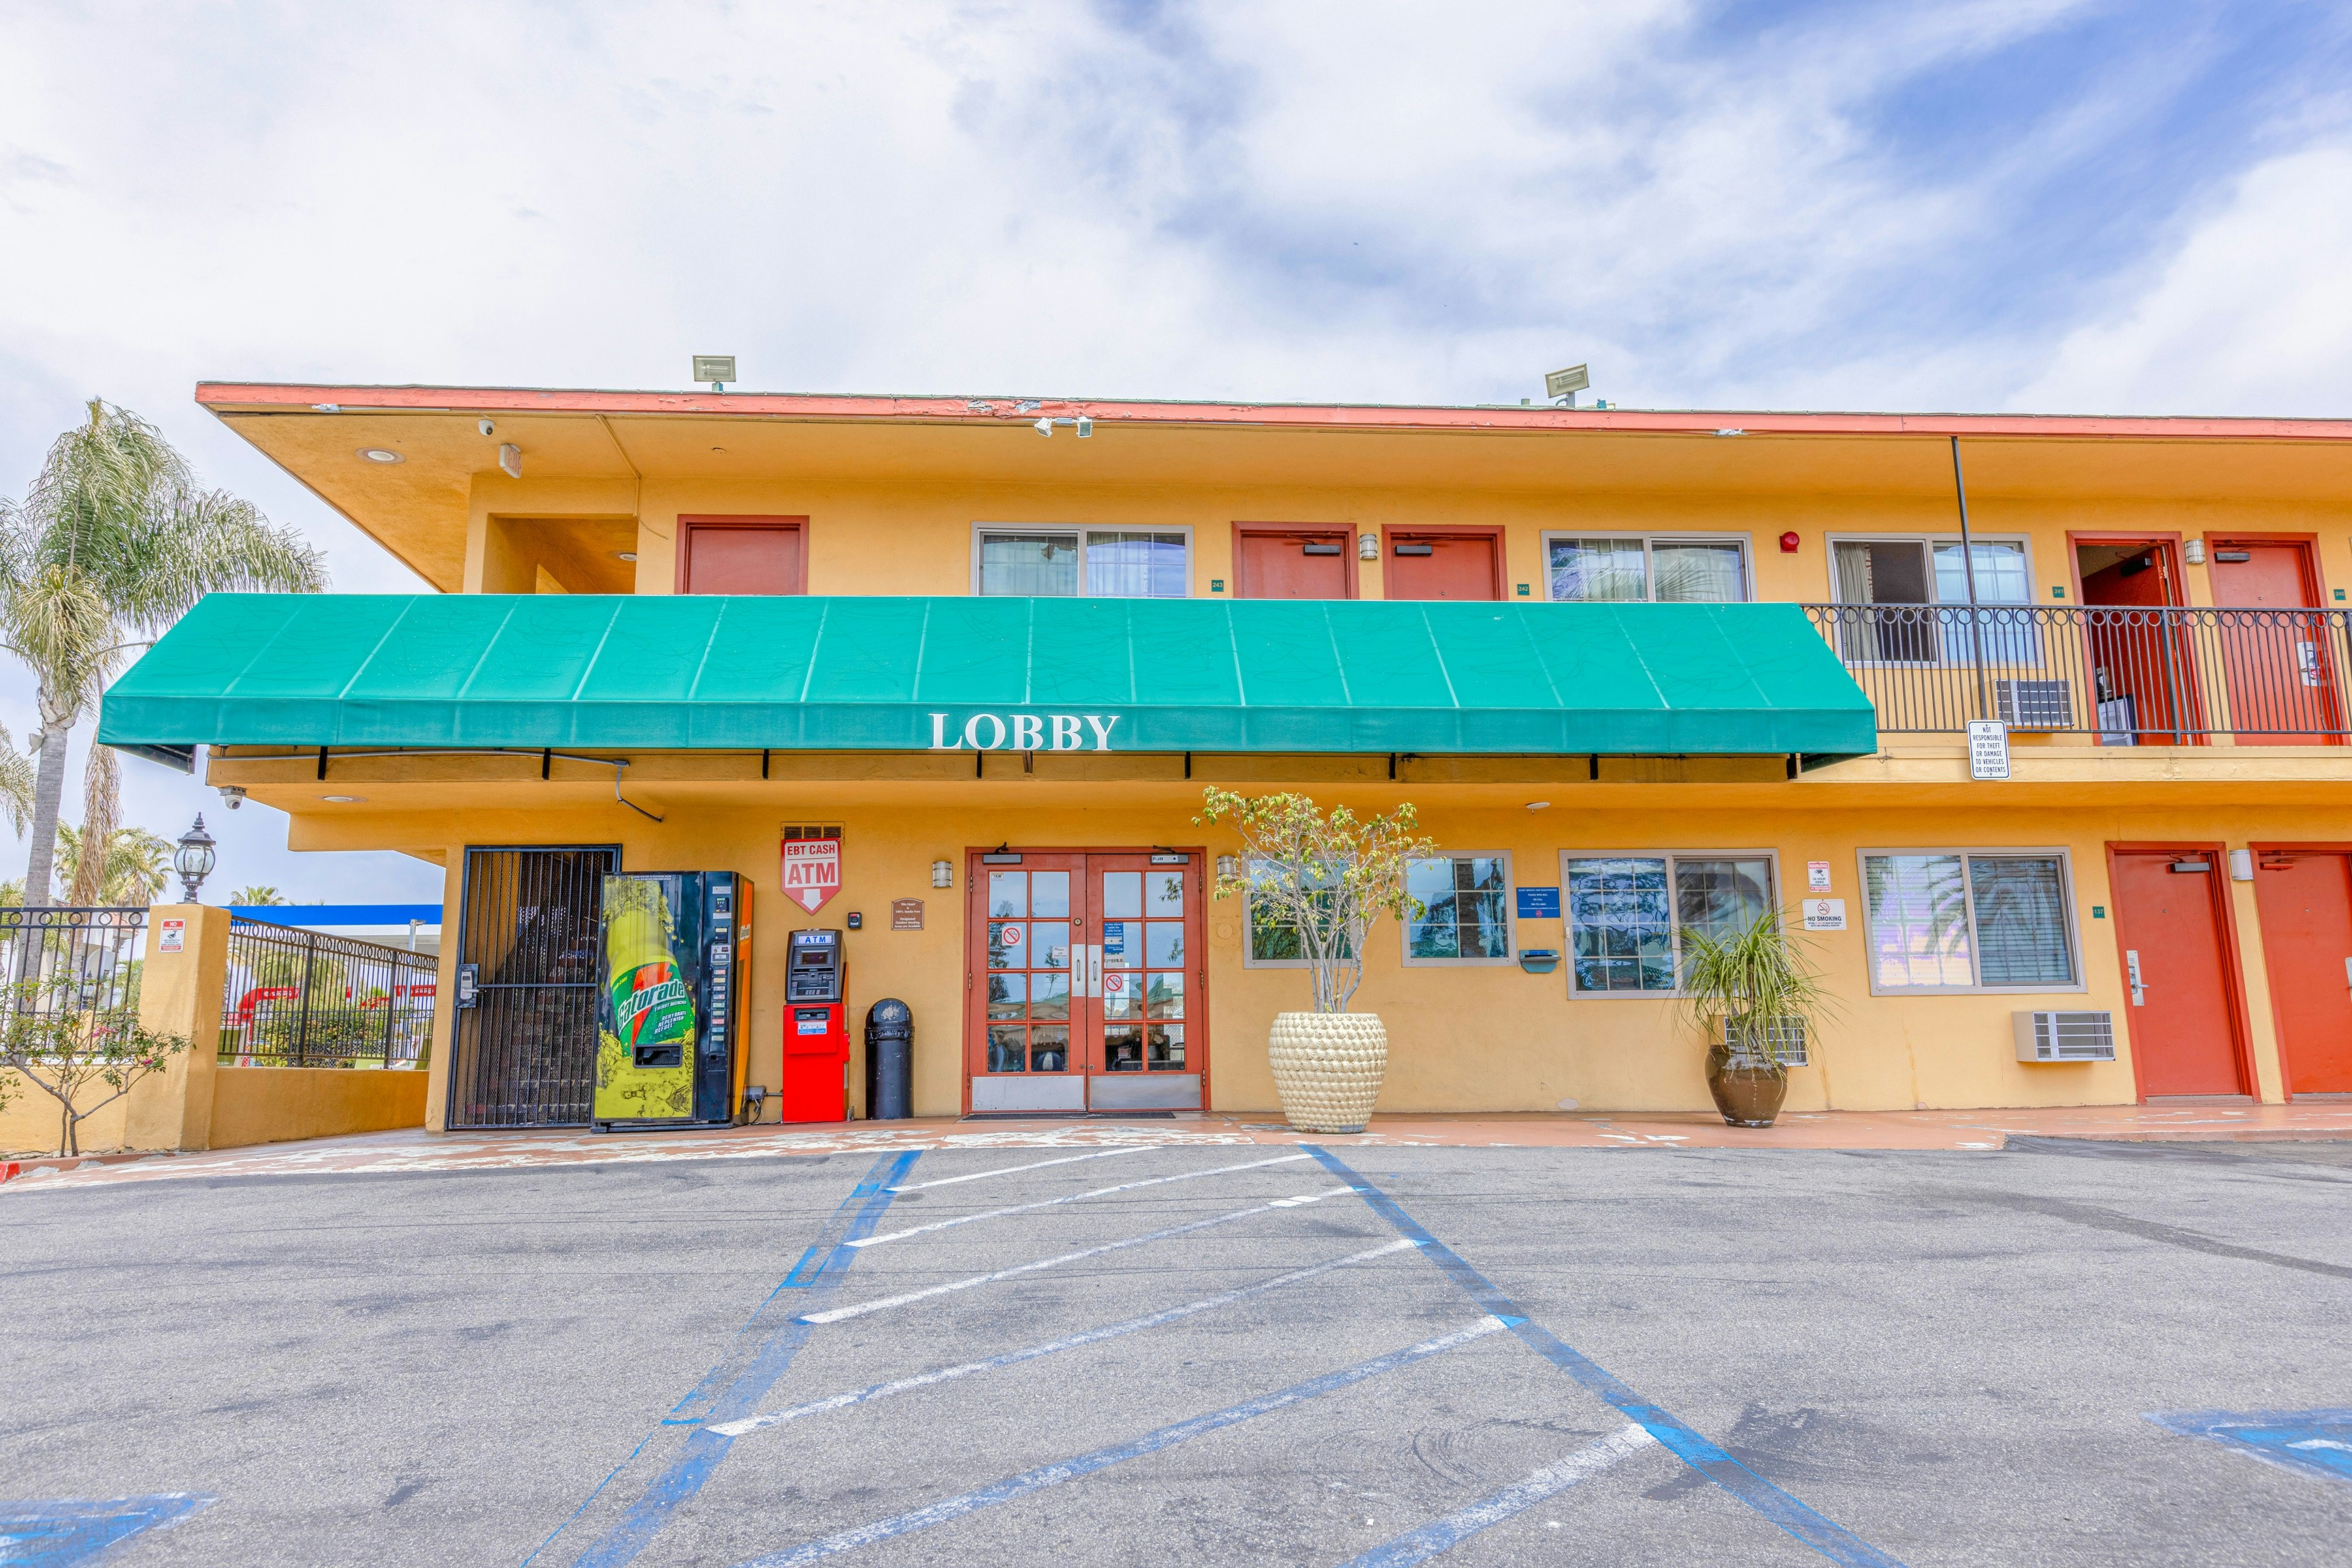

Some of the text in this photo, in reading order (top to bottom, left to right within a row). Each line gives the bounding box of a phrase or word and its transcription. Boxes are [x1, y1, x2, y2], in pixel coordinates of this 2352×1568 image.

[928, 713, 1121, 751] LOBBY
[787, 844, 836, 855] EBT CASH
[787, 862, 836, 885] ATM
[618, 979, 685, 1036] Gatorade
[654, 1002, 670, 1012] THIRST
[657, 1015, 685, 1028] REPLENISH
[661, 1011, 687, 1021] REHYDRATE
